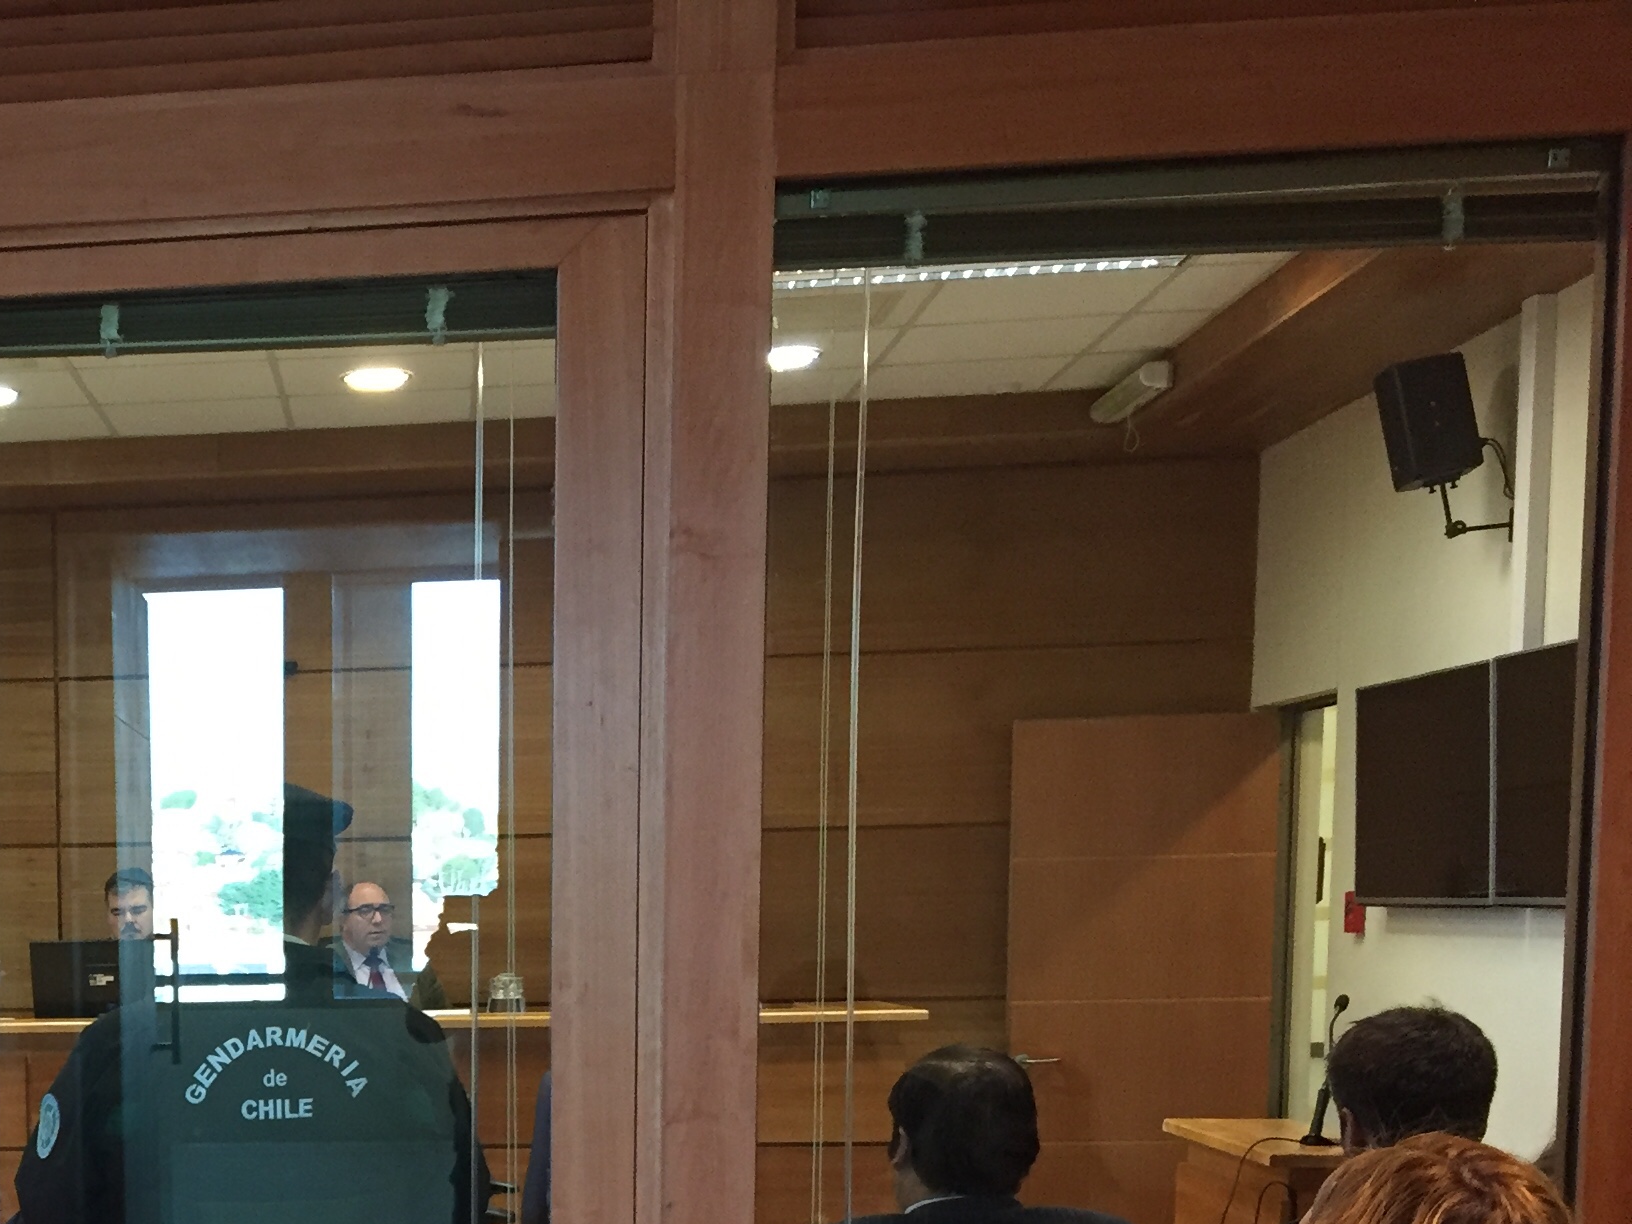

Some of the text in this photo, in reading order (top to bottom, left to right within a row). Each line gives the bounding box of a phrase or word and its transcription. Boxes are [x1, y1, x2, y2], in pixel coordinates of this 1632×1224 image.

[184, 1026, 368, 1104] GENDARMERIA
[263, 1068, 288, 1088] de
[241, 1098, 314, 1120] CHILE
